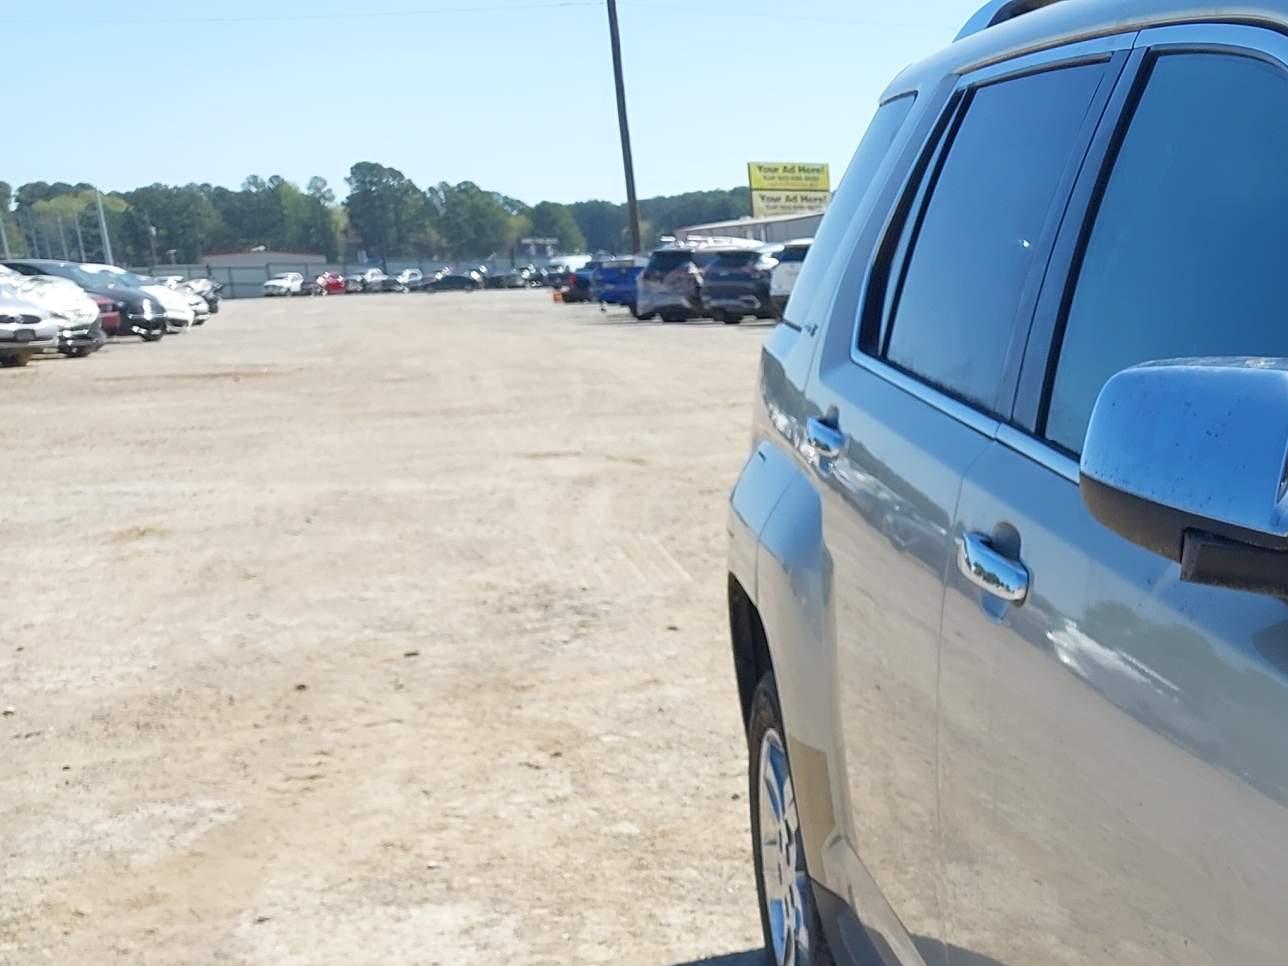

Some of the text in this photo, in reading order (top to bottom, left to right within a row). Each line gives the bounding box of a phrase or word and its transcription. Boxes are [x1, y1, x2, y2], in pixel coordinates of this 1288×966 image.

[757, 165, 779, 174] Your
[782, 165, 796, 174] Ad
[759, 194, 782, 203] Your
[785, 194, 798, 203] Ad
